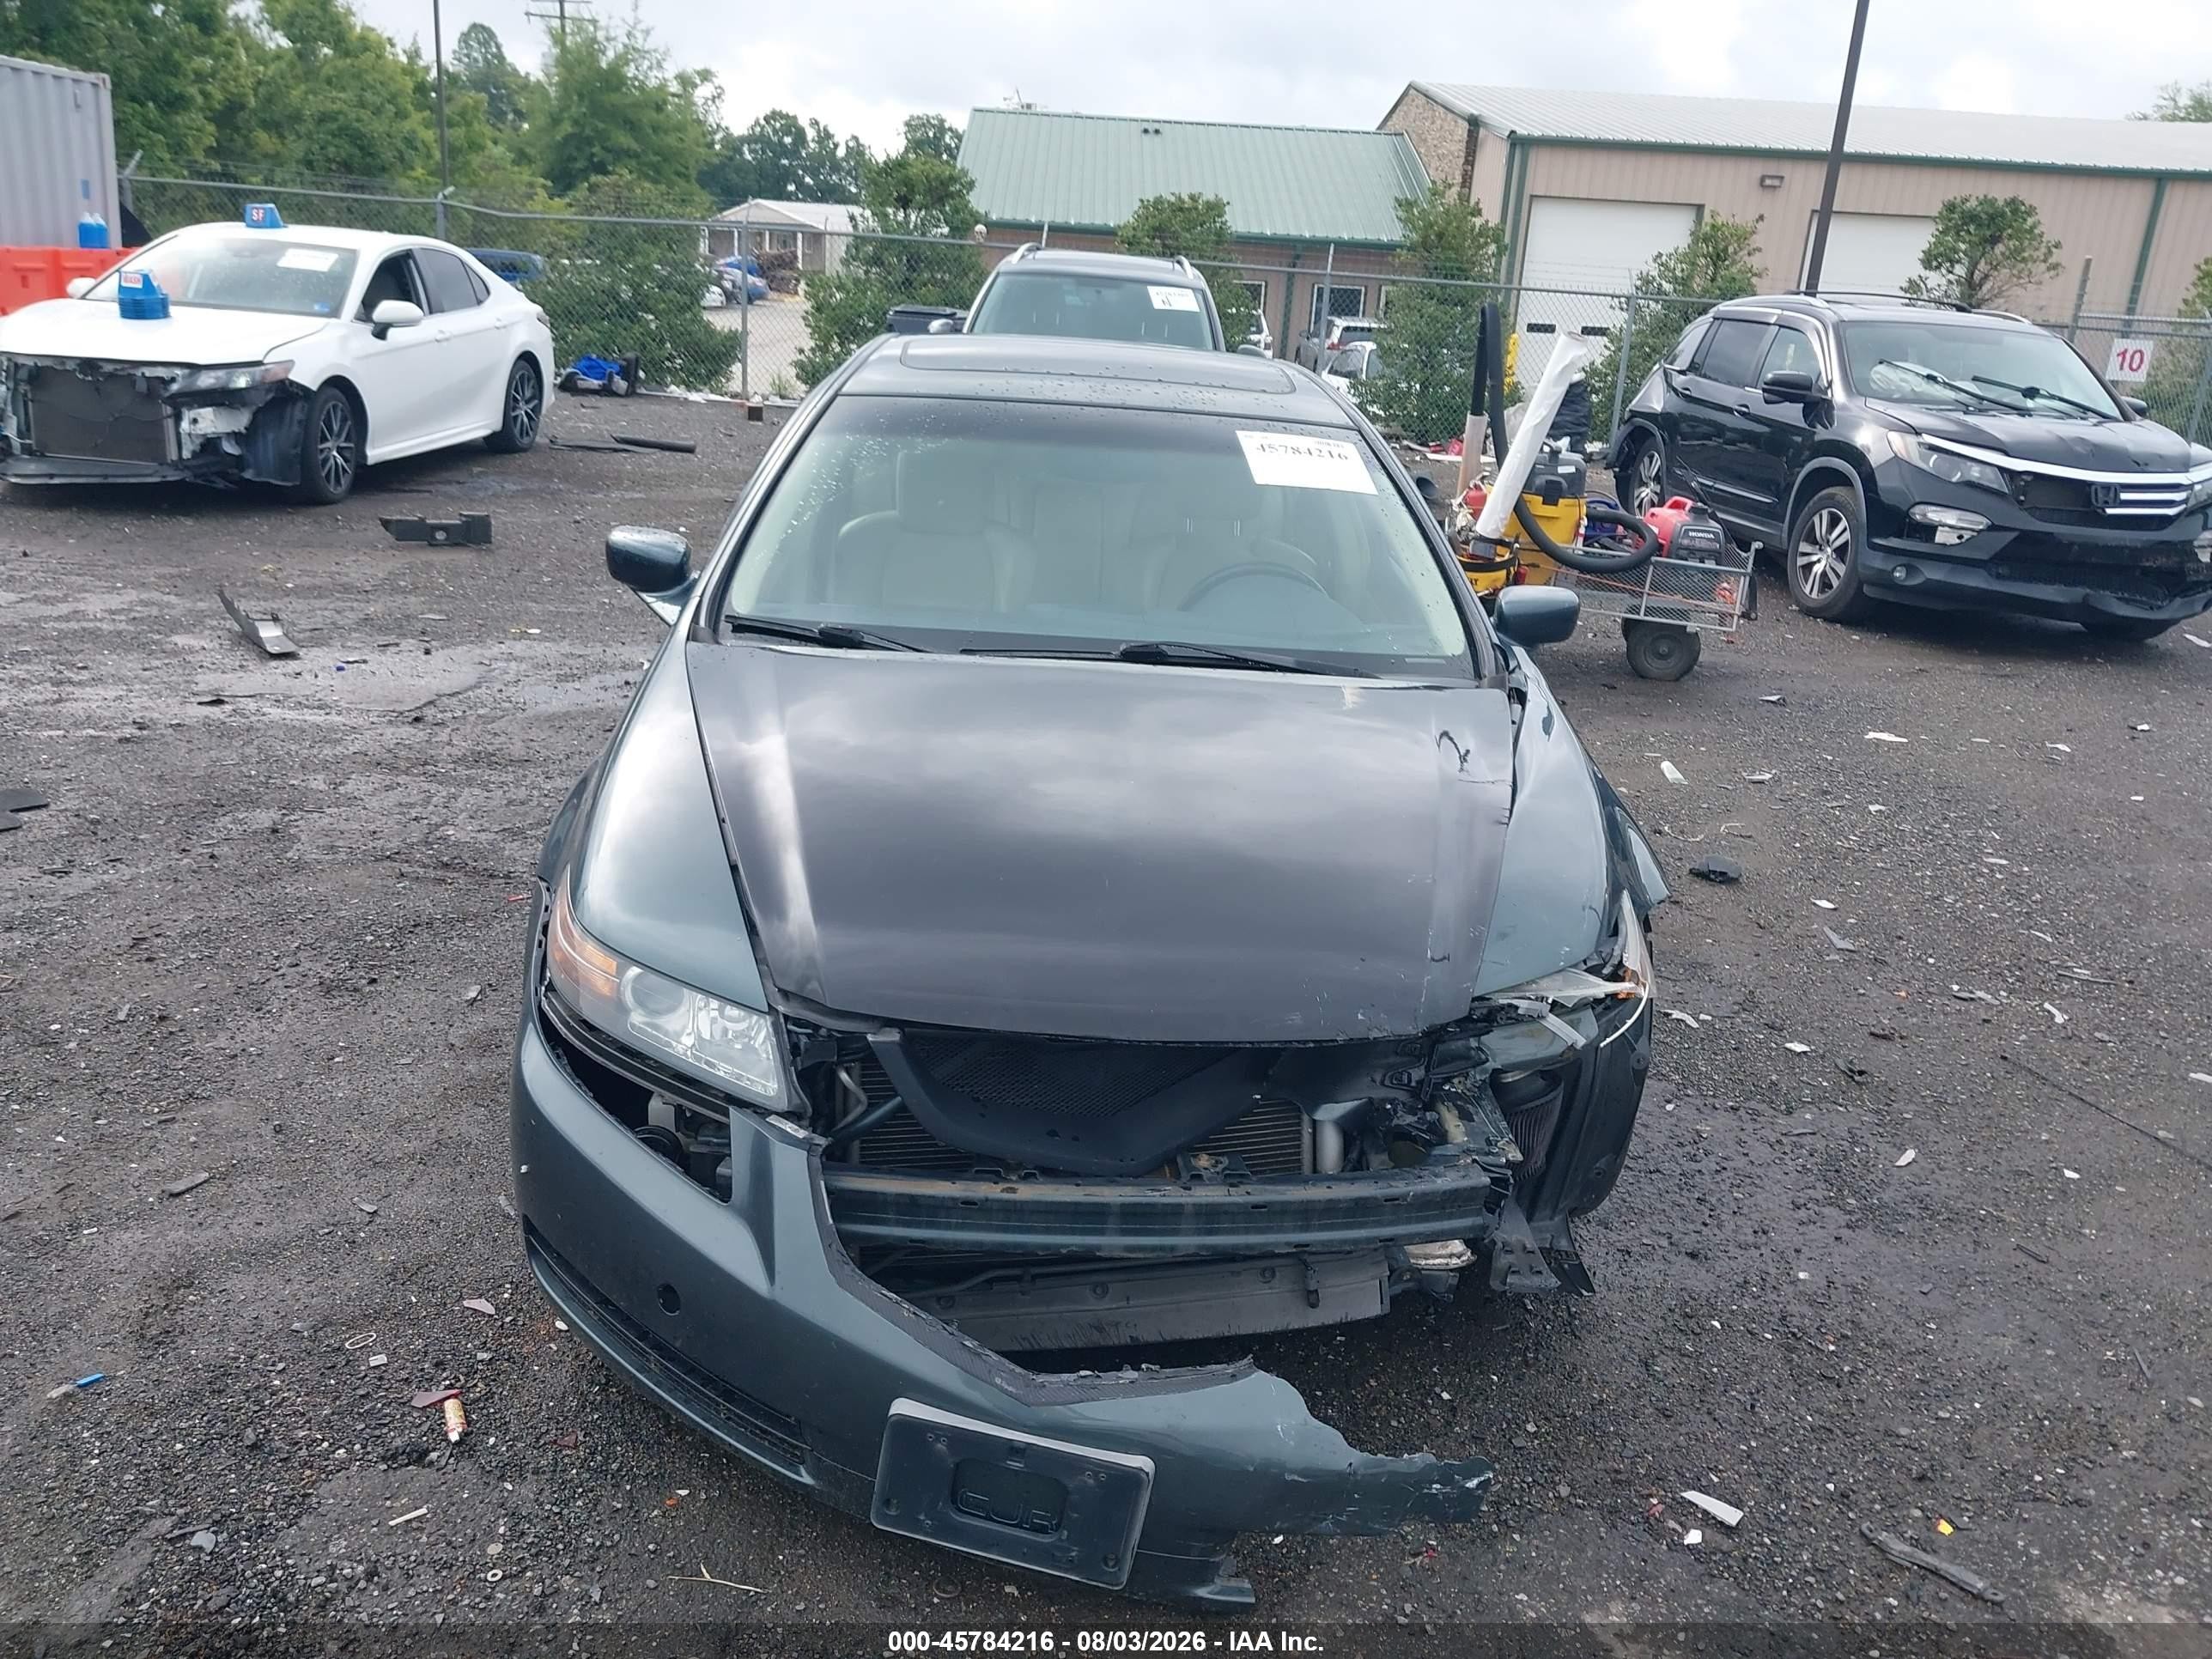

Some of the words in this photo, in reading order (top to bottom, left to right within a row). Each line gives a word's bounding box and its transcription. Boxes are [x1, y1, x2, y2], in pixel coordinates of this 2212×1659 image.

[252, 208, 264, 221] SF
[2116, 348, 2145, 373] 10
[1255, 442, 1350, 461] 45784216
[1688, 530, 1716, 539] HONDA
